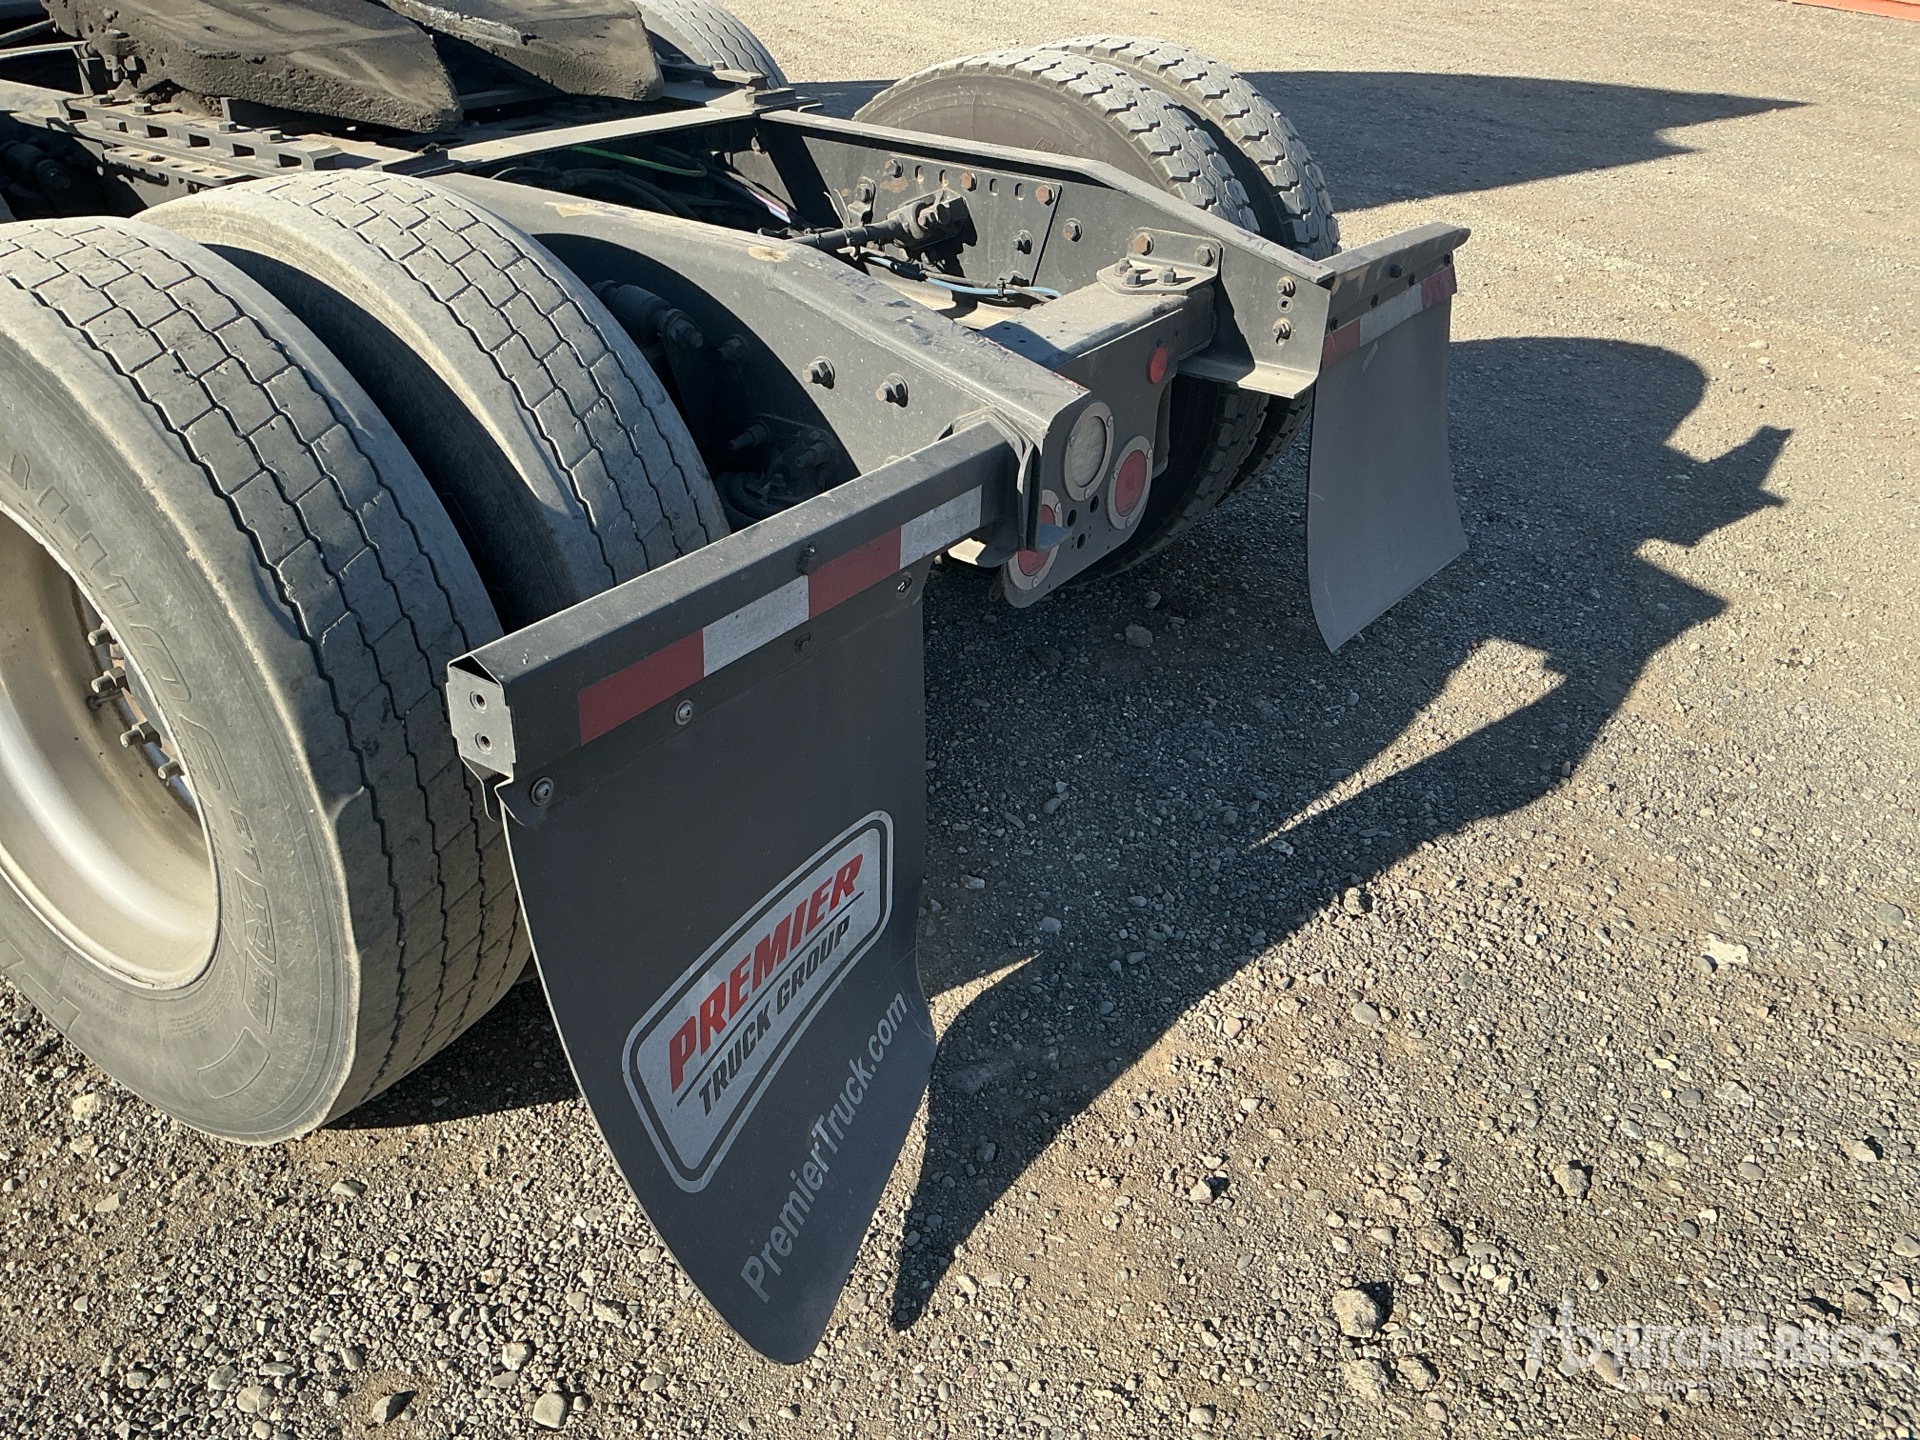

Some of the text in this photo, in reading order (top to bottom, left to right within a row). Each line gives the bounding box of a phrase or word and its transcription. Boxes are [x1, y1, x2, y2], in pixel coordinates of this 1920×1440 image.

[669, 853, 864, 1094] PREMIER
[699, 915, 851, 1117] TRUCK GROUP
[741, 992, 909, 1303] PremierTruck.com
